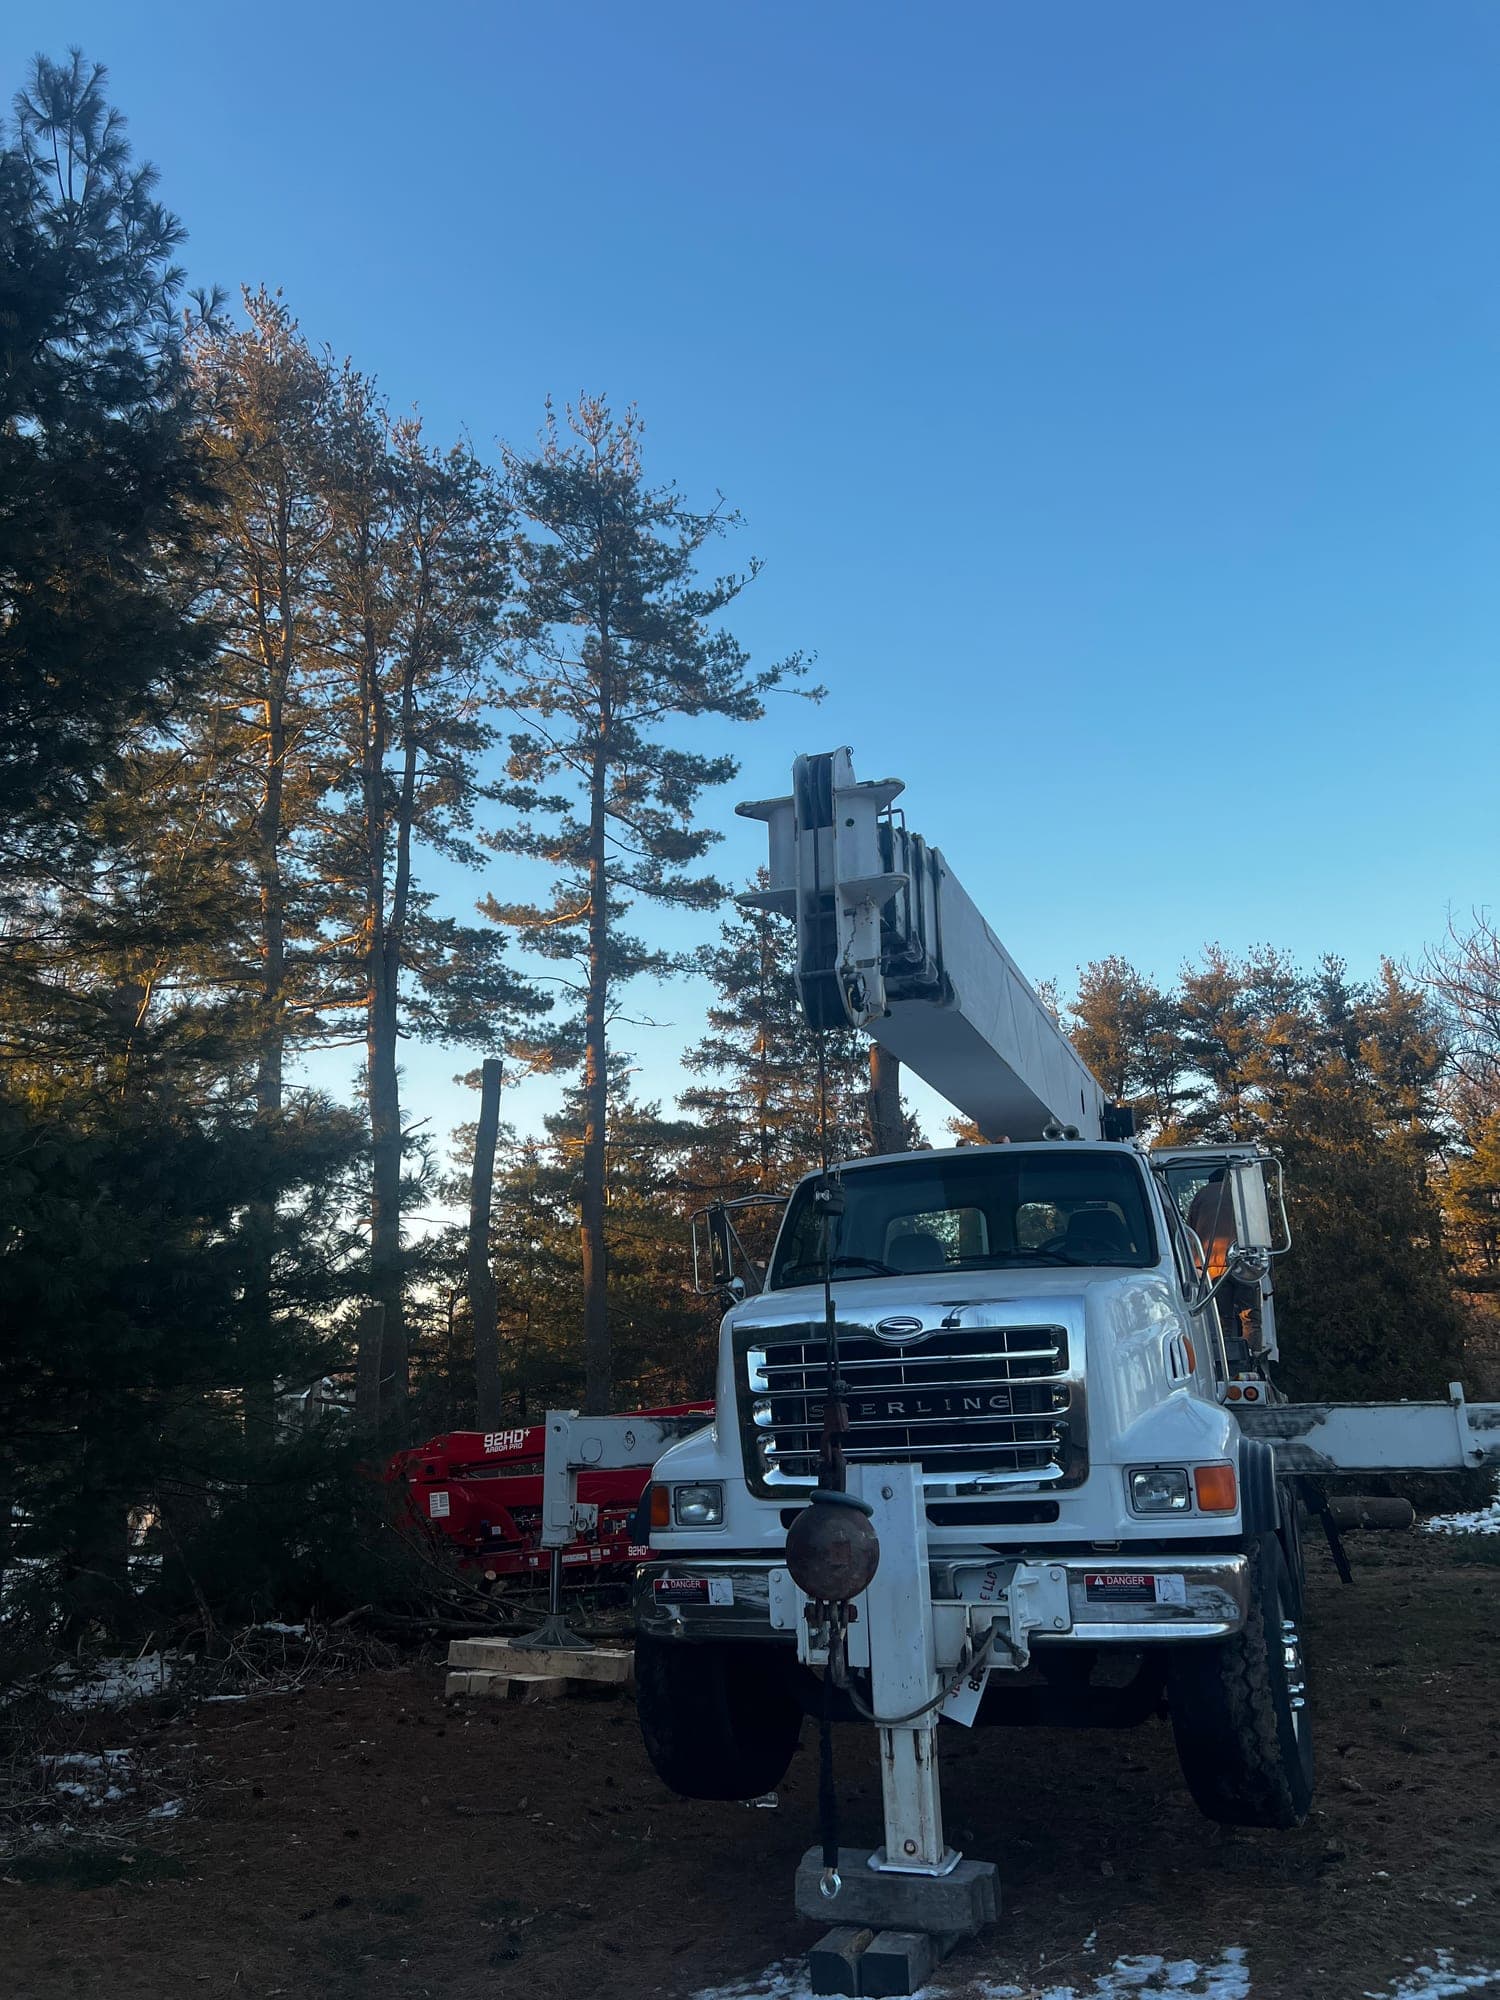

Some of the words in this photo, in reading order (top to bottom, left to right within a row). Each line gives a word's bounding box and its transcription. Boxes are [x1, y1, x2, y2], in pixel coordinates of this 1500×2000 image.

[809, 1395, 1010, 1418] SERLING
[485, 1444, 508, 1454] ARBOR
[509, 1442, 523, 1450] PRO
[670, 1580, 701, 1589] DANGER
[1107, 1576, 1145, 1585] DANGER
